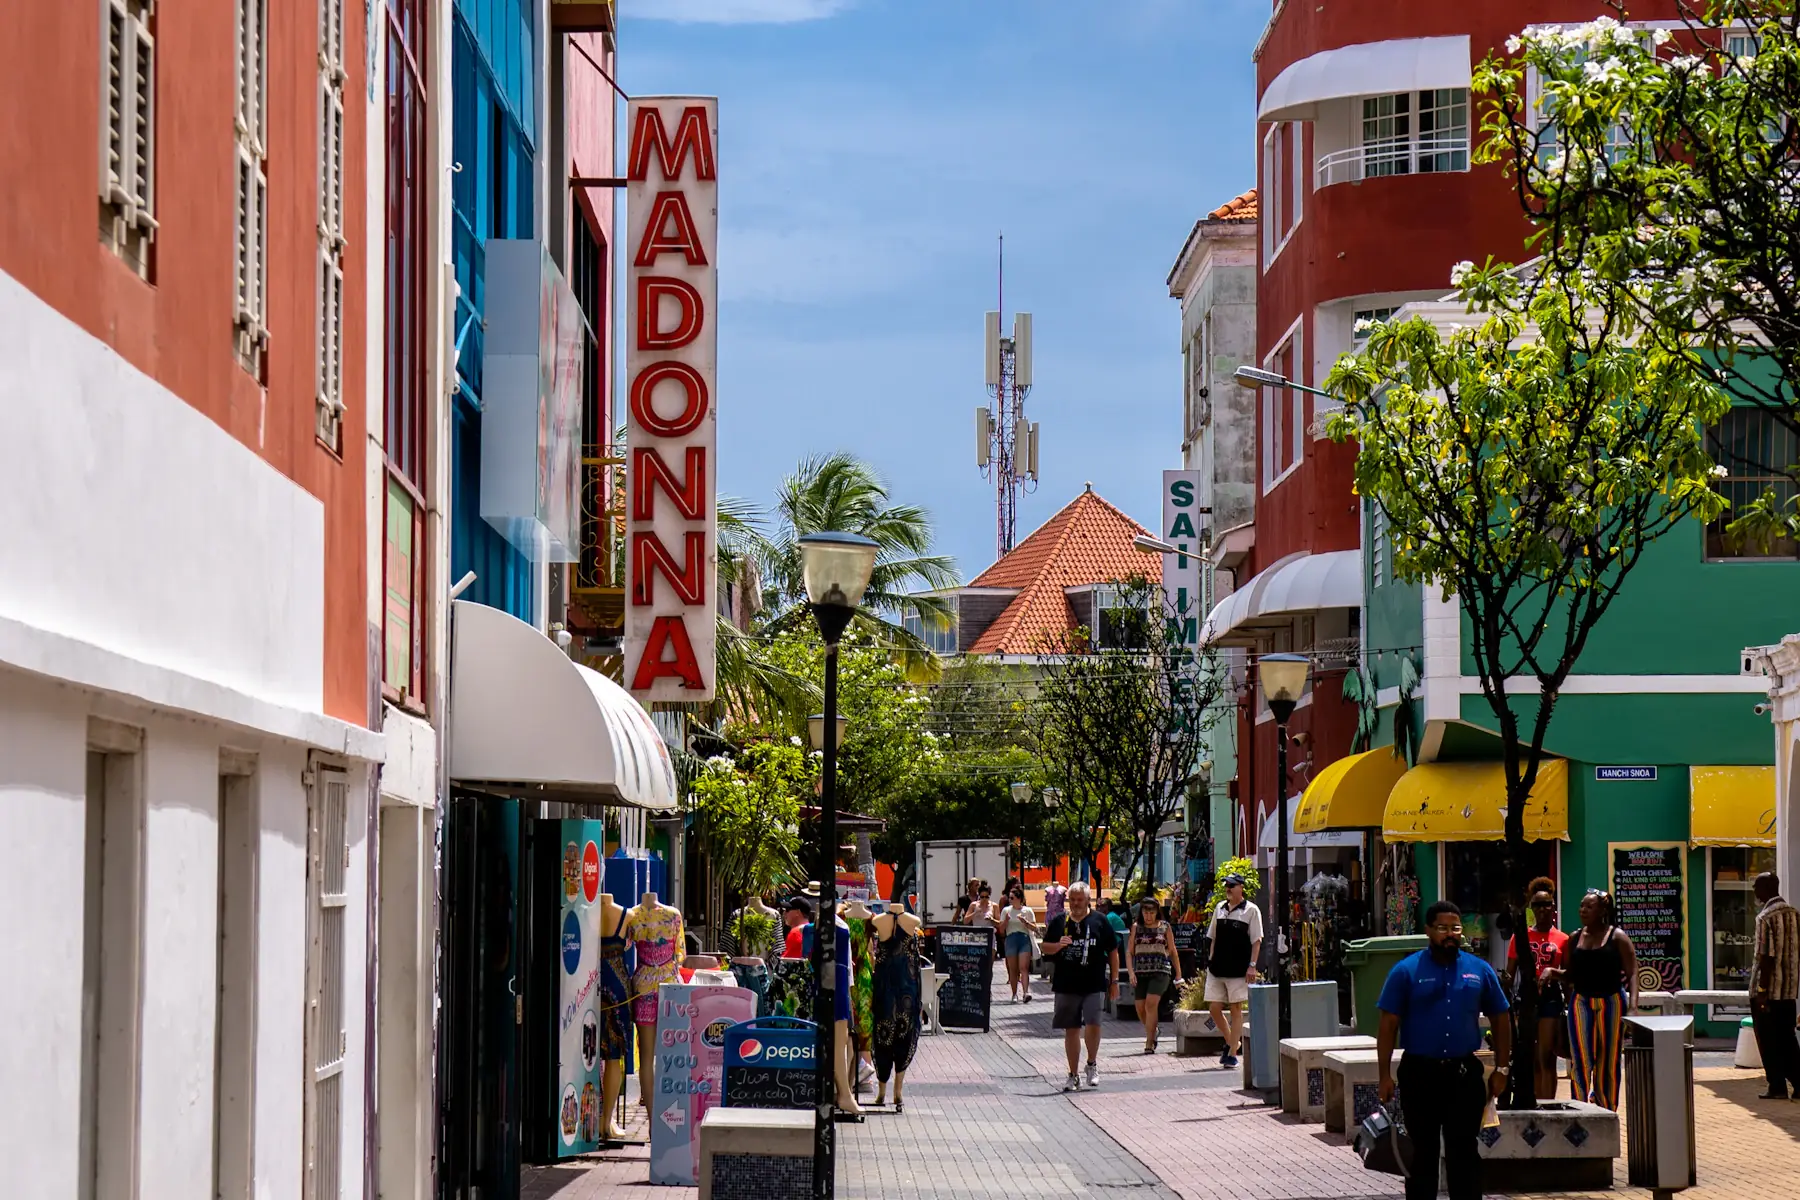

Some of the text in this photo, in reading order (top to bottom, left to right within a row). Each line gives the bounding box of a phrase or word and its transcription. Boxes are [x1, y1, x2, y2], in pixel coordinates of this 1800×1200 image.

[627, 106, 716, 690] MADONNA
[1169, 480, 1196, 569] SAI
[1602, 769, 1650, 777] HANCHI SNOA
[1628, 851, 1665, 859] WELCOME
[663, 1001, 699, 1018] I've
[662, 1027, 697, 1047] got
[766, 1044, 815, 1061] pepsi
[661, 1053, 698, 1072] you
[660, 1077, 712, 1095] Babe
